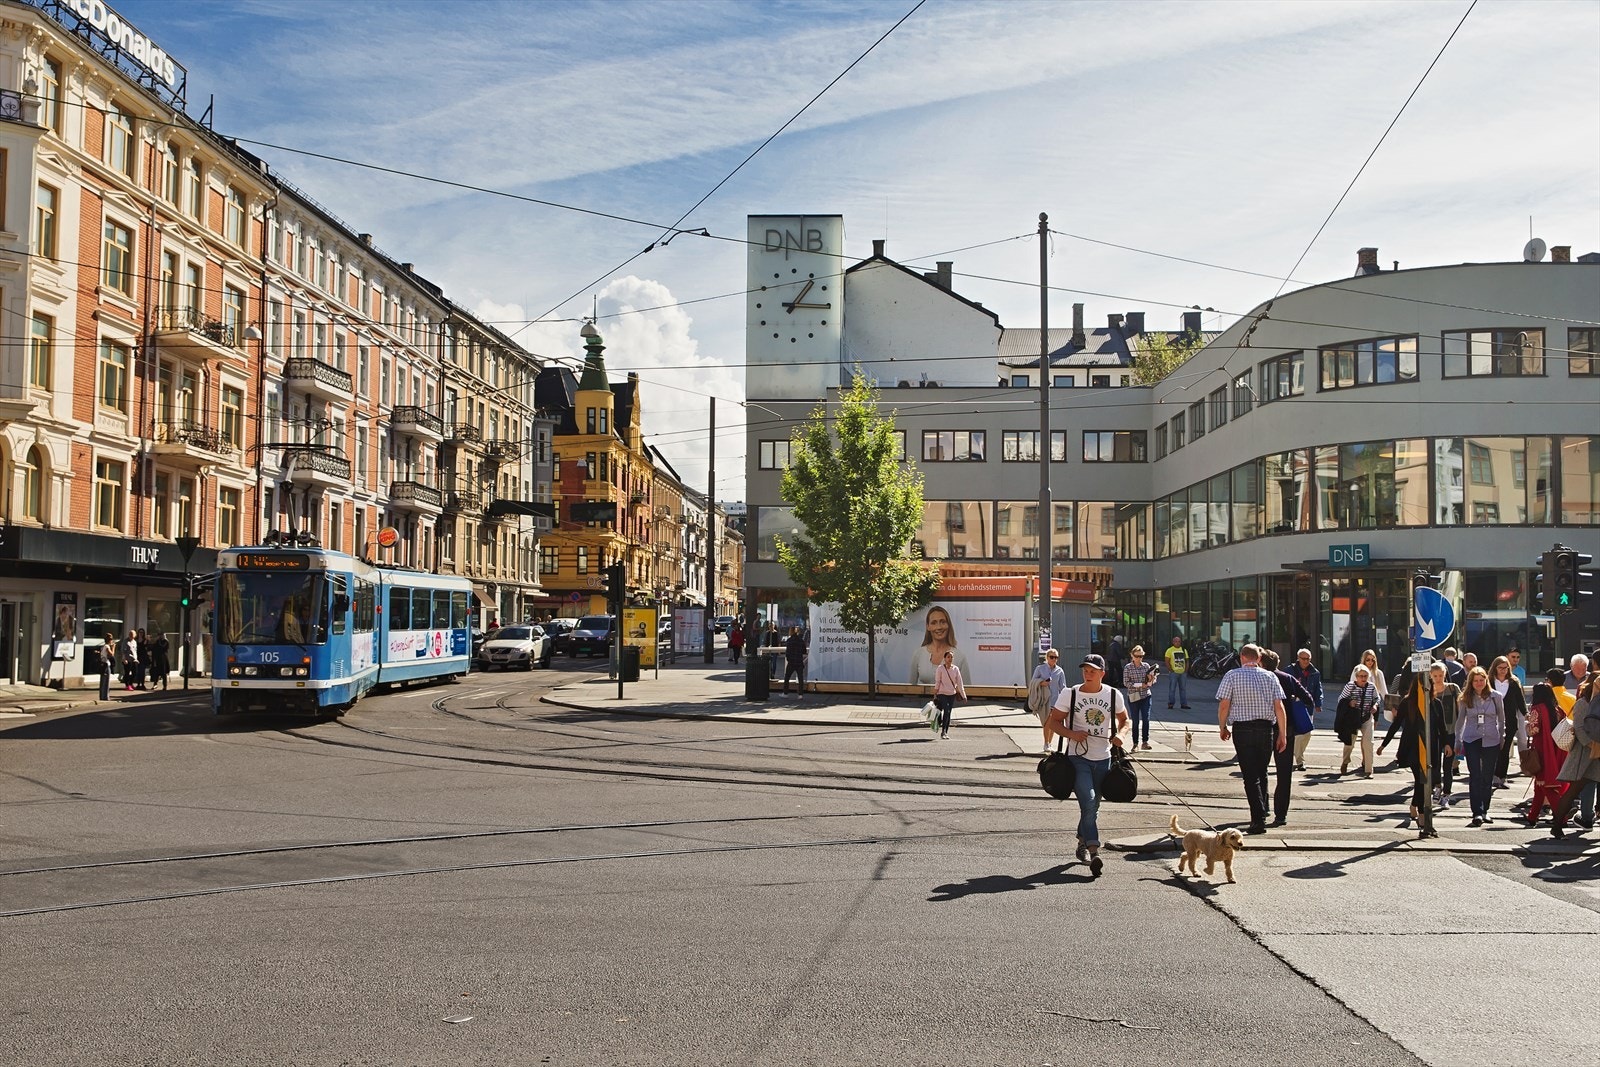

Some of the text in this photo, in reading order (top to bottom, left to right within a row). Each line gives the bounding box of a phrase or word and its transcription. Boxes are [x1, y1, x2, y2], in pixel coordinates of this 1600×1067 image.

[60, 0, 175, 86] cDonald's
[765, 223, 824, 261] DNB
[131, 546, 160, 565] THUNE
[1333, 546, 1364, 566] DNB
[947, 583, 956, 591] du
[957, 583, 1012, 591] forhåndsstemme
[895, 627, 909, 636] valg
[827, 635, 866, 645] bydelsutvalg
[819, 646, 834, 654] gjøre
[836, 645, 846, 653] det
[260, 652, 280, 662] 105
[1073, 697, 1112, 713] WARRIORS
